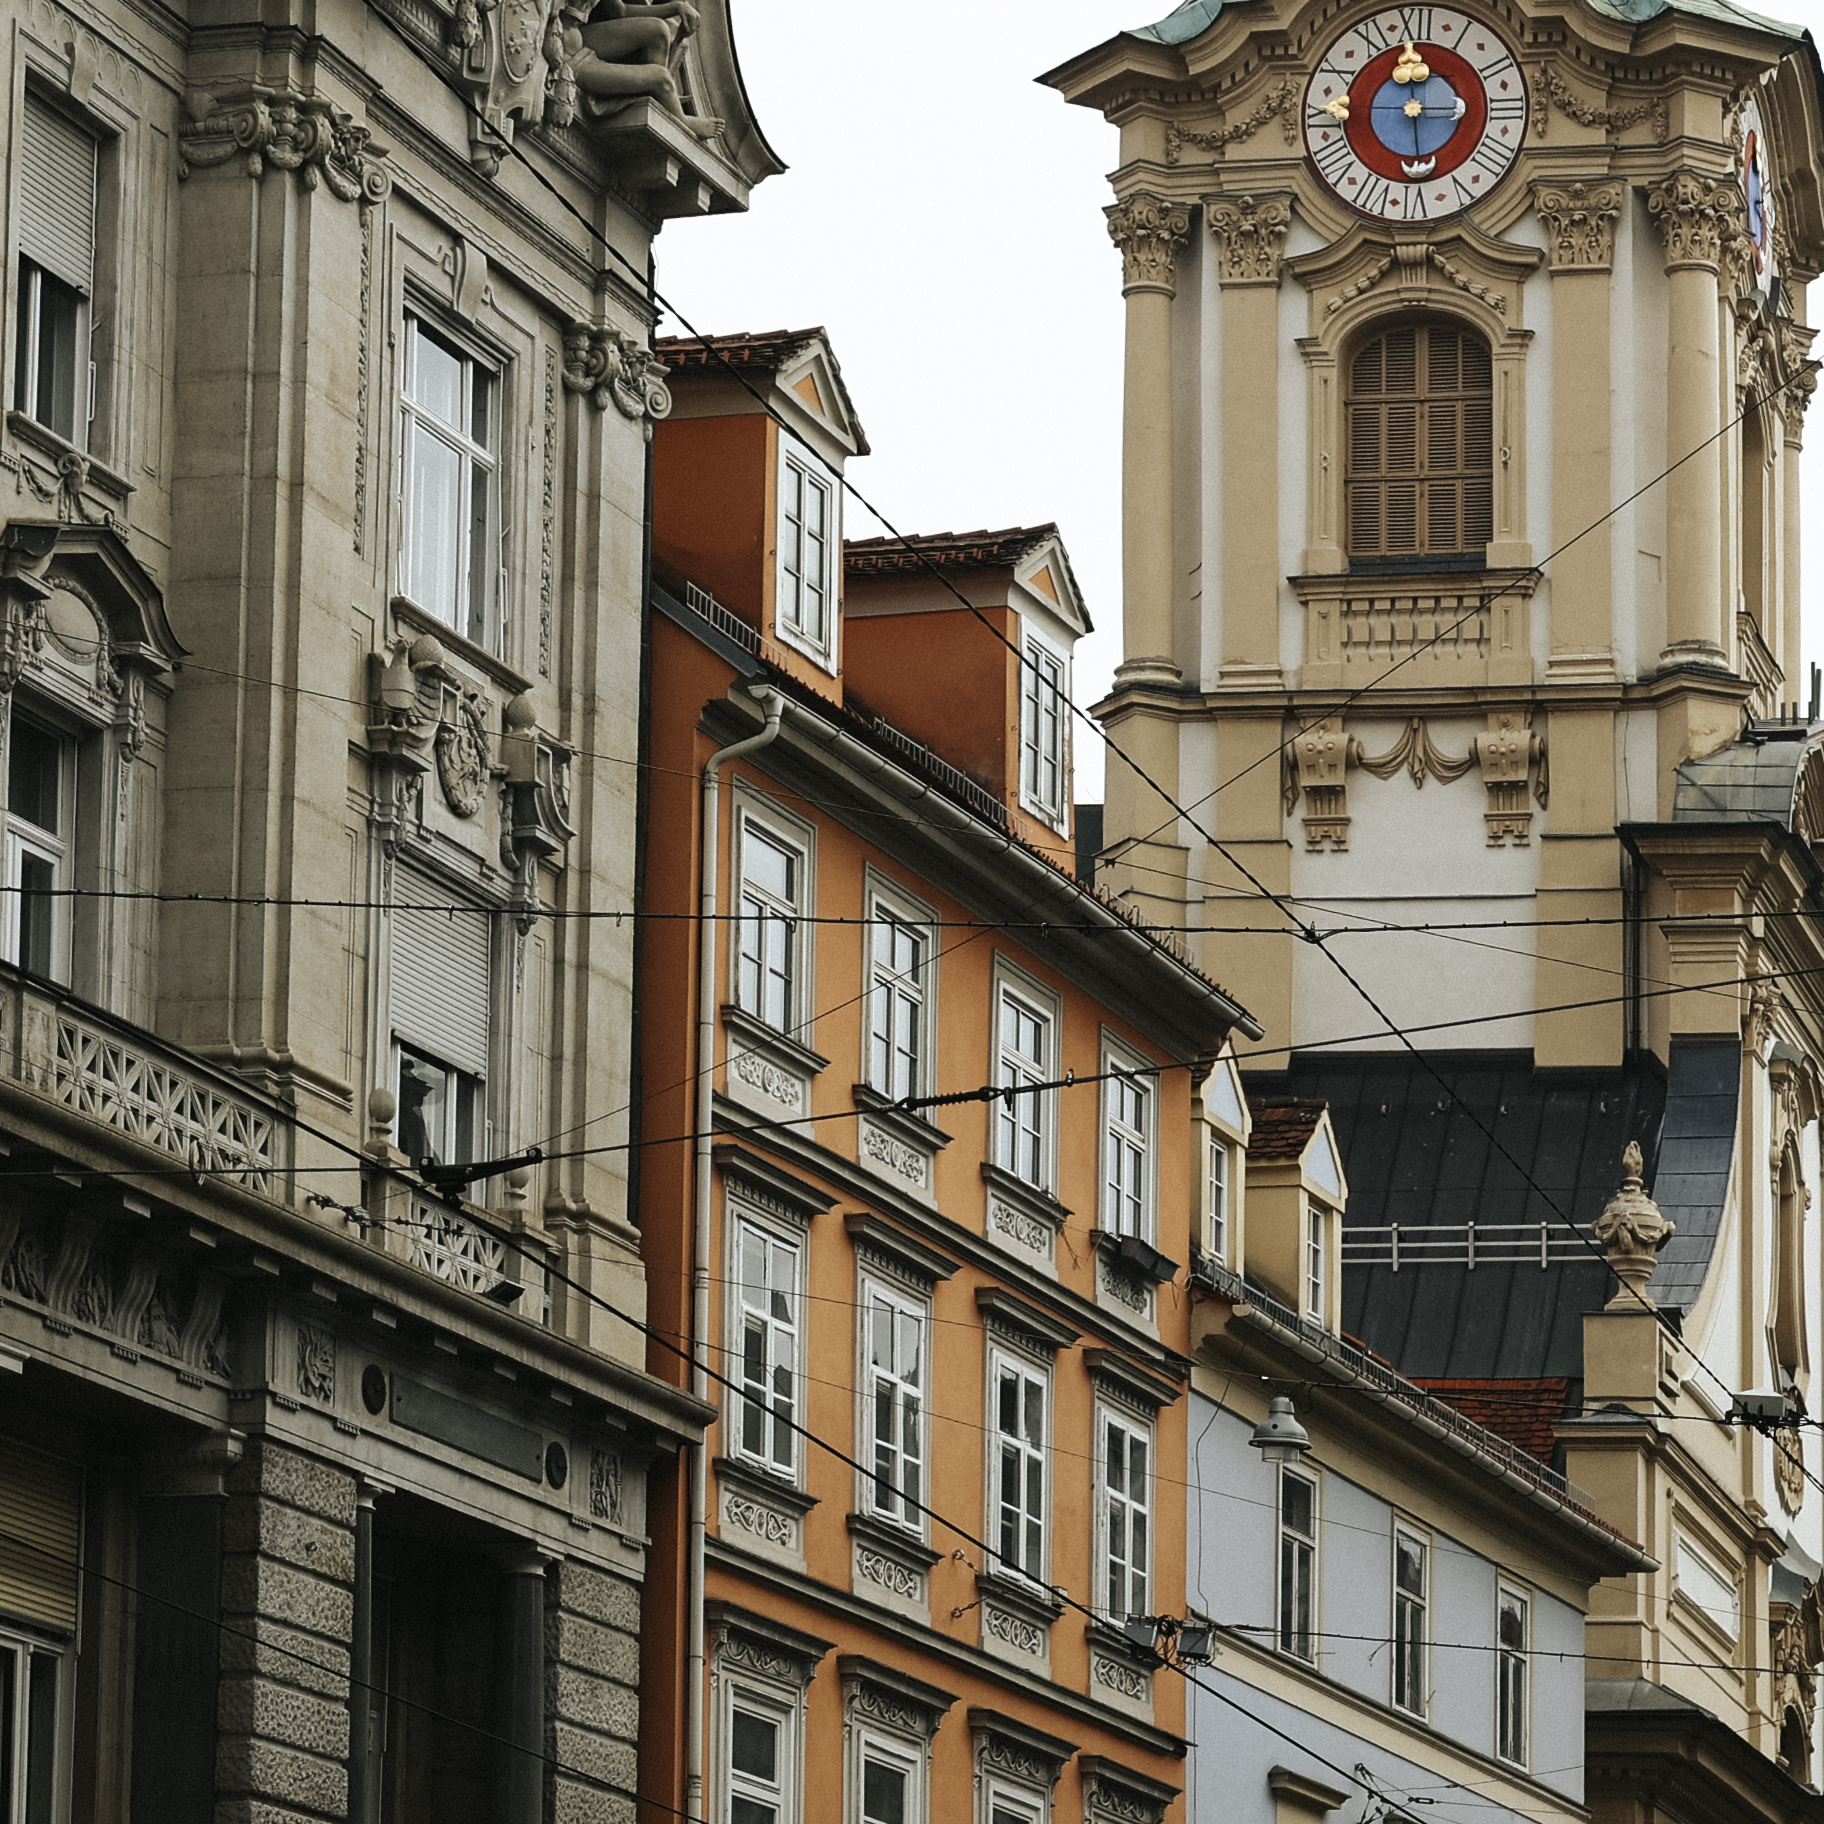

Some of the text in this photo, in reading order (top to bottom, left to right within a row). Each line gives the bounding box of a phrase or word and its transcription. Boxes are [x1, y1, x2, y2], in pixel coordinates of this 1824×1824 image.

[1352, 18, 1392, 60] XI
[1398, 8, 1434, 42] XII
[1451, 20, 1473, 51] I
[1320, 57, 1357, 87] X
[1478, 53, 1514, 81] II
[1489, 95, 1524, 121] III
[1313, 134, 1356, 189] VIII
[1471, 133, 1516, 179] IIII
[1351, 172, 1392, 217] VII
[1401, 184, 1429, 219] VI
[1451, 174, 1478, 207] V
